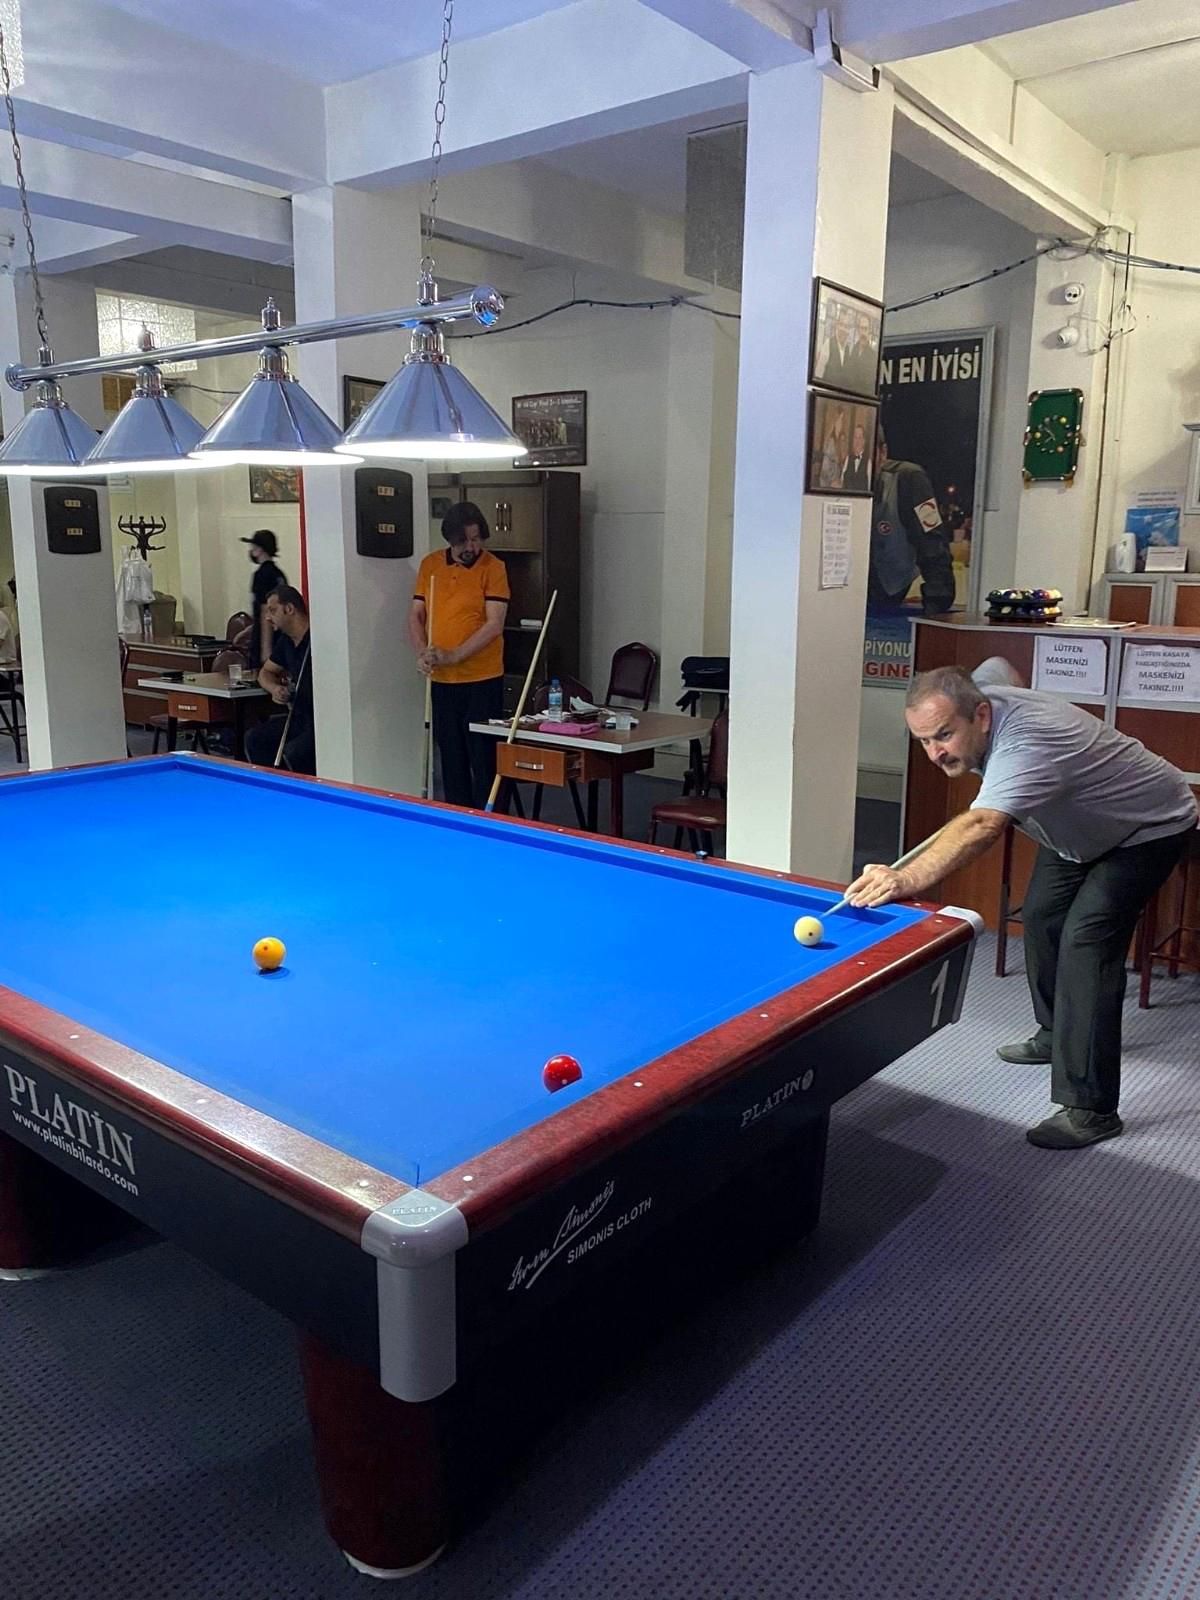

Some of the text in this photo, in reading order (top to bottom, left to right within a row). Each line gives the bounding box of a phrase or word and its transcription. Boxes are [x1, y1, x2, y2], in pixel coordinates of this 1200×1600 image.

[898, 356, 926, 383] EN
[931, 345, 980, 381] İYİSİ
[865, 636, 912, 658] PİYONU
[1045, 656, 1089, 666] MASKENİZİ
[1054, 643, 1083, 653] LÜTFEN
[1138, 671, 1185, 680] MASKENİZİ
[930, 959, 949, 1029] 1
[12, 1109, 139, 1197] www.platinbilardo.com
[567, 1197, 653, 1264] SIMONIS CLOTH
